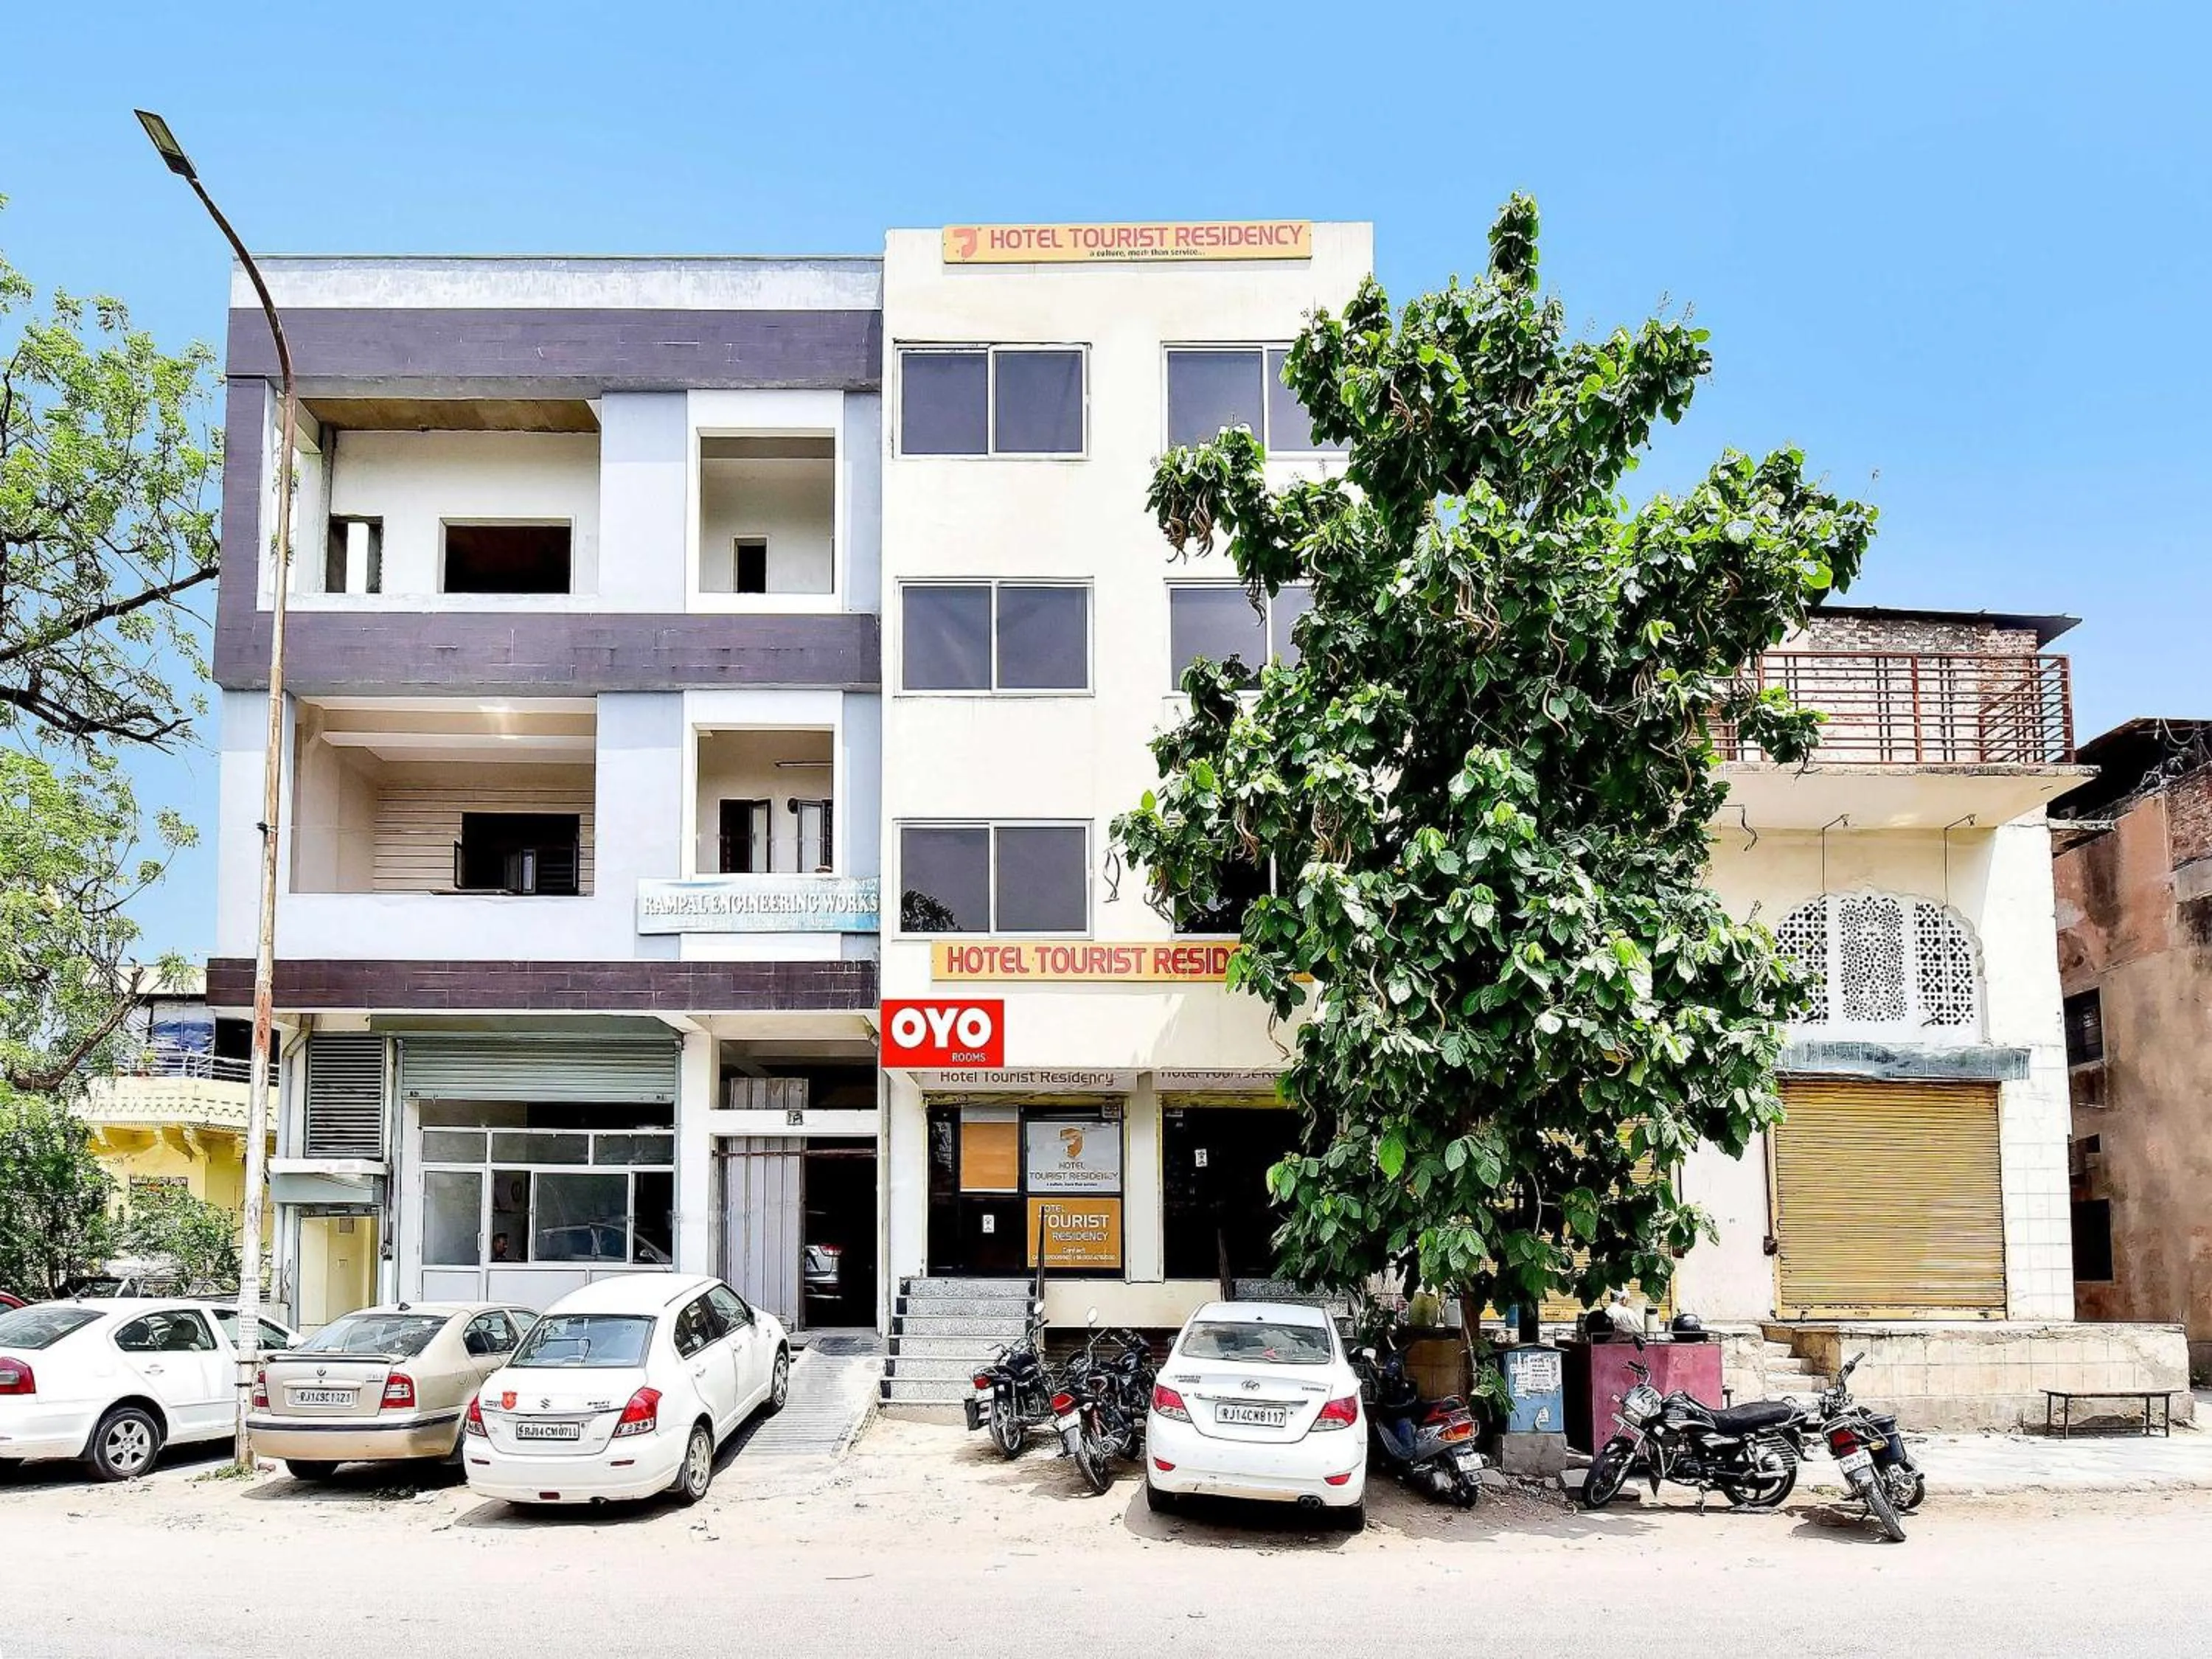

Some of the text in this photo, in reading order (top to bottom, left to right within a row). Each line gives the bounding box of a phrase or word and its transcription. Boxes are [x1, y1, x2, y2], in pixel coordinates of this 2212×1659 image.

[990, 225, 1303, 248] HOTEL TOURIST RESIDENCY
[1151, 248, 1169, 256] than
[643, 892, 879, 915] RAMPAL ENGINEERING WORKS
[947, 946, 1242, 974] HOTEL TOURIST RESID
[891, 1007, 992, 1048] OYO
[952, 1052, 986, 1062] ROOMS
[940, 1071, 977, 1083] Hotel
[984, 1071, 1035, 1083] Tourist
[1058, 1161, 1085, 1169] HOTEL
[1029, 1172, 1119, 1180] TOURIST RESIDENCY
[1052, 1231, 1109, 1242] RESIDENCY
